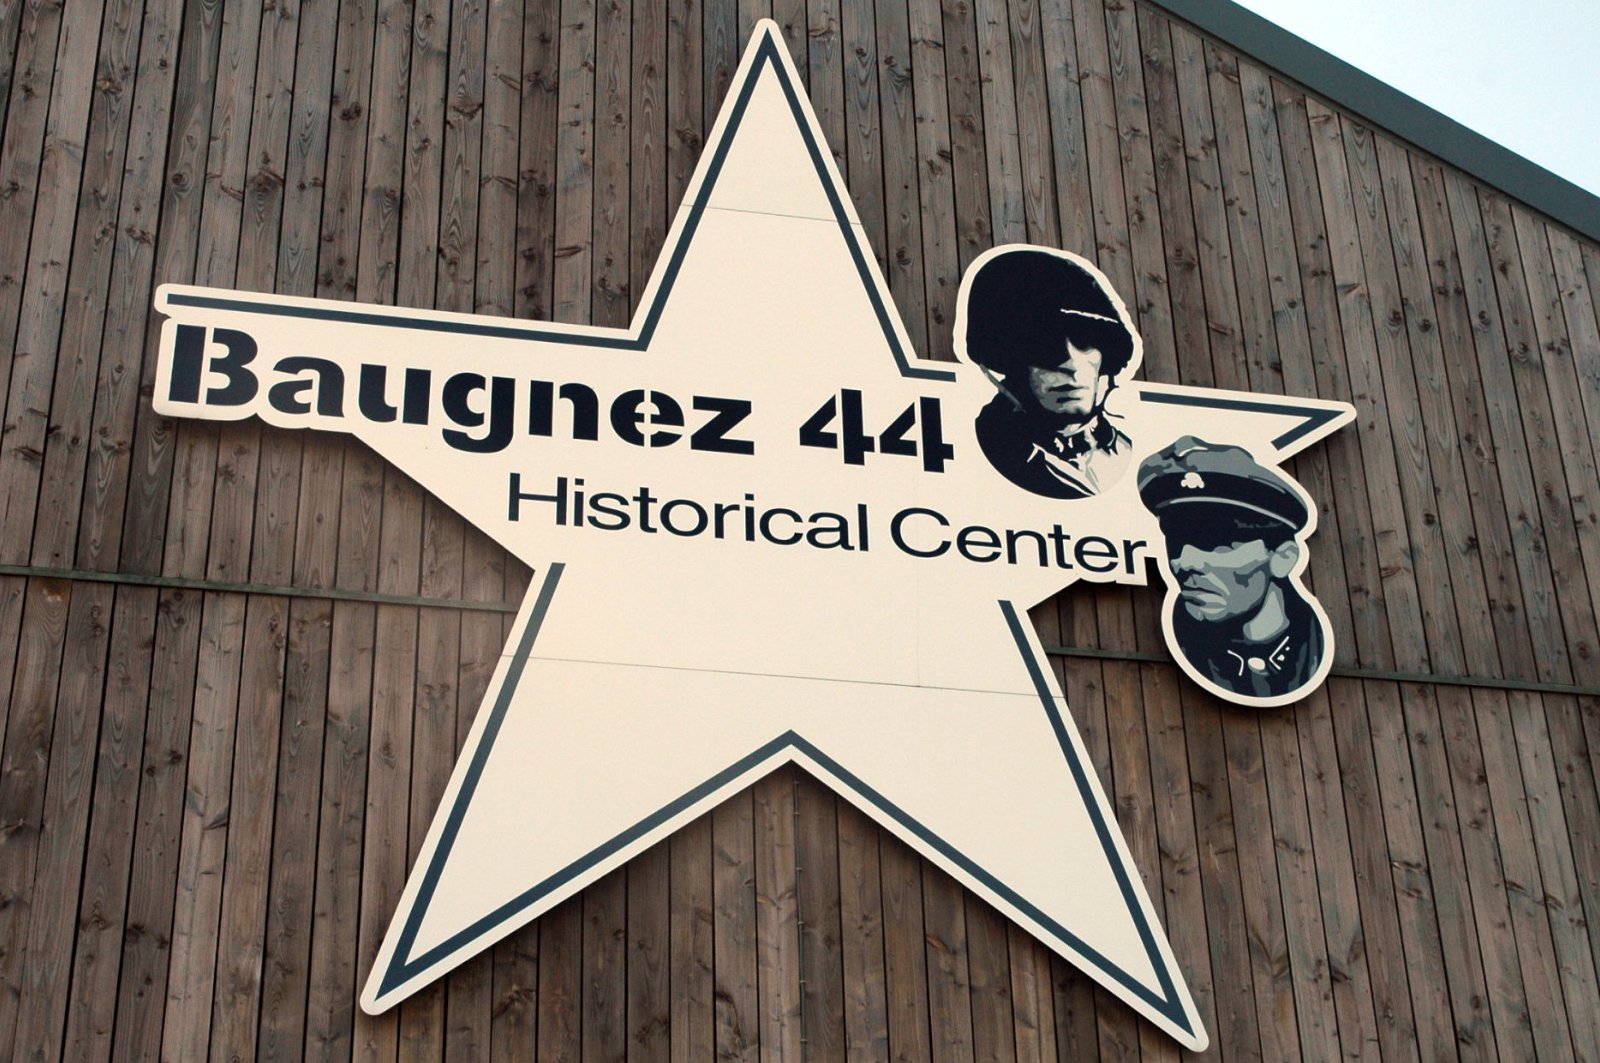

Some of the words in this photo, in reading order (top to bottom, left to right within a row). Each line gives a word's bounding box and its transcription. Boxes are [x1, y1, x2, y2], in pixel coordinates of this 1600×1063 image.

[168, 323, 755, 455] Baugnez
[799, 388, 955, 474] 44
[508, 472, 869, 552] Historical
[890, 507, 1148, 575] Center
